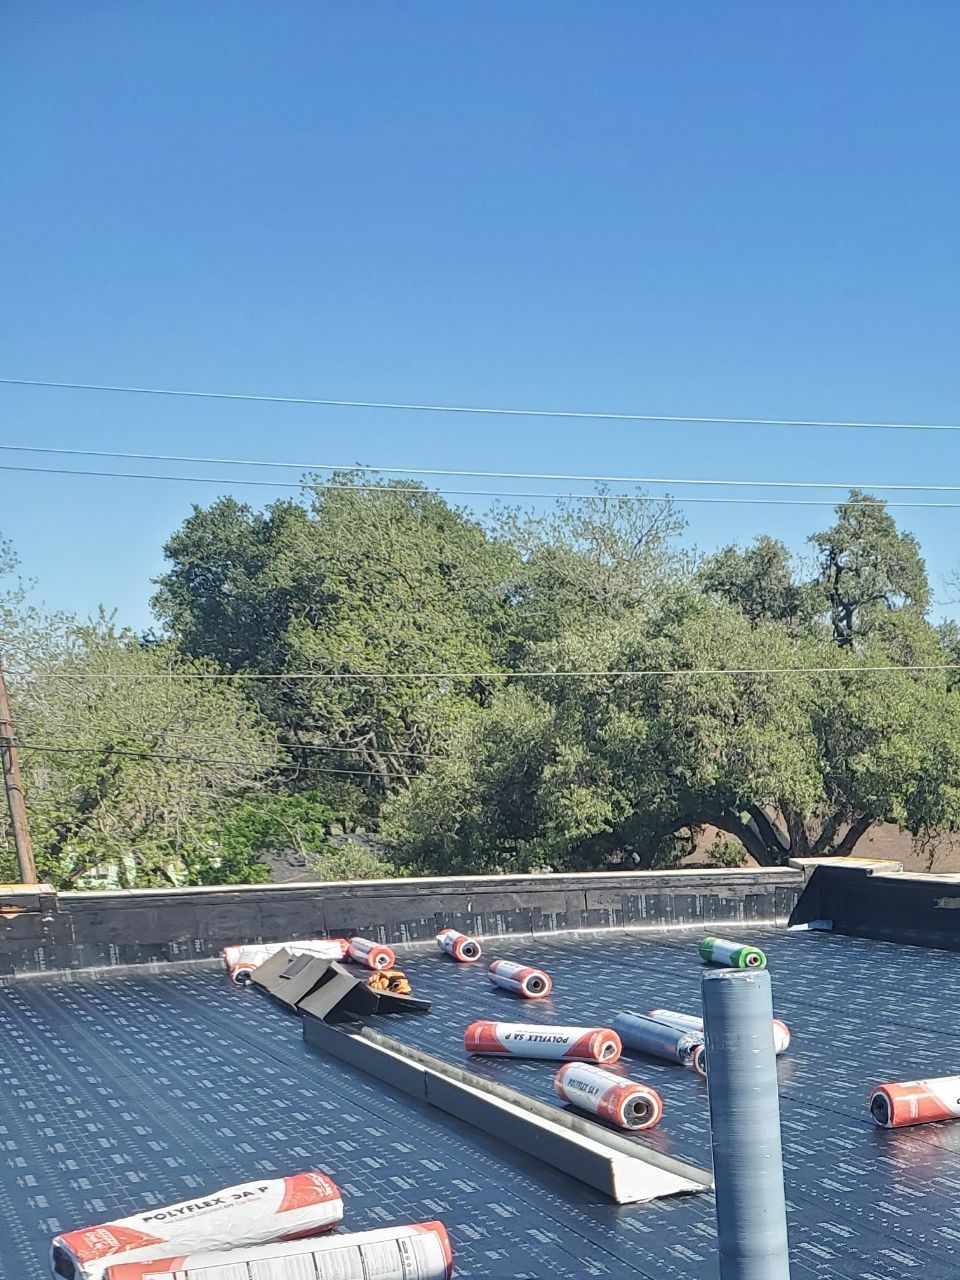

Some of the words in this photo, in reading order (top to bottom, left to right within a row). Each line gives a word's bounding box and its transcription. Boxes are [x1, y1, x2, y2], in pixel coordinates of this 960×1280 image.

[504, 1032, 511, 1040] P
[513, 1033, 526, 1042] SA
[527, 1035, 570, 1045] POLYFLEX
